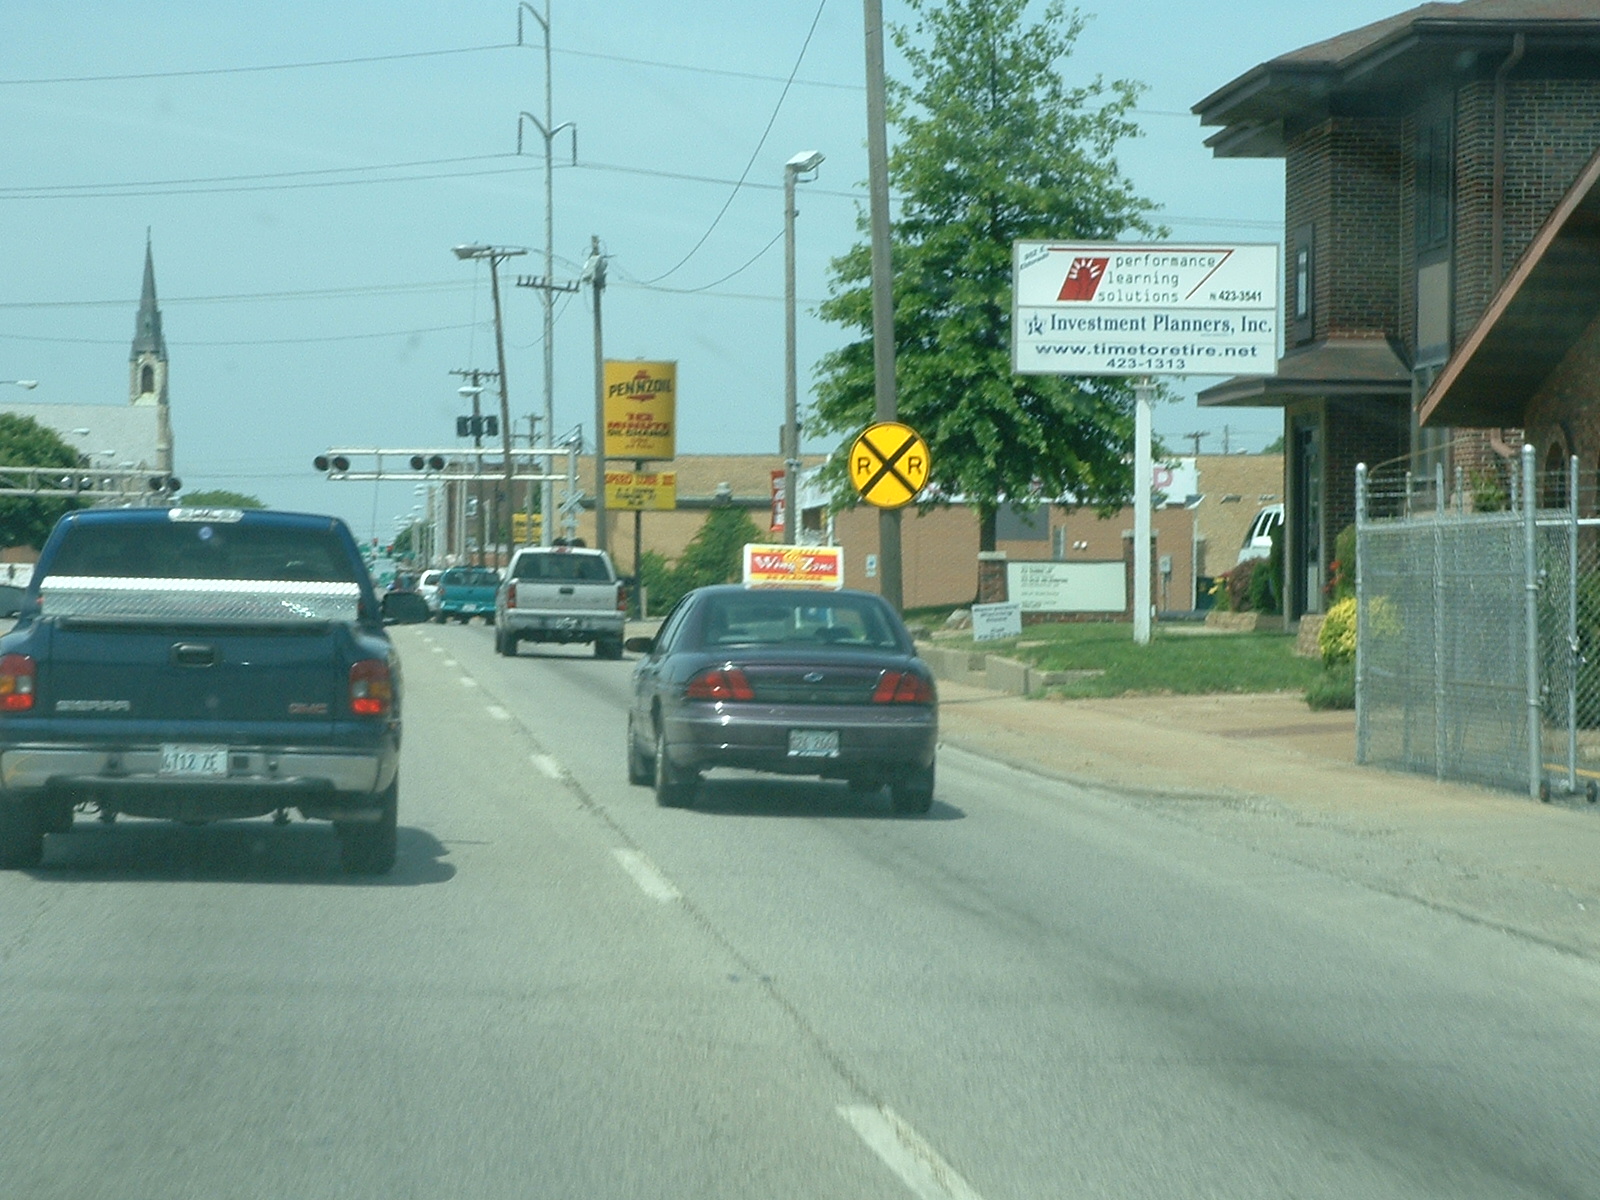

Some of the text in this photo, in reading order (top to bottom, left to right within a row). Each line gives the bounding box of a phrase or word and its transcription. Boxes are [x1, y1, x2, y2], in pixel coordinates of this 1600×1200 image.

[1116, 254, 1215, 268] performance
[1109, 271, 1179, 287] learning
[1098, 289, 1179, 302] solutions
[1218, 290, 1262, 301] 423-3541
[1050, 313, 1272, 335] Investment Planners, Inc.
[1035, 342, 1257, 357] www.timetoretire.net
[1106, 357, 1186, 370] 423-1313
[608, 379, 672, 398] PENNZOIL
[857, 456, 922, 475] R R
[753, 555, 835, 574] Wing Zone
